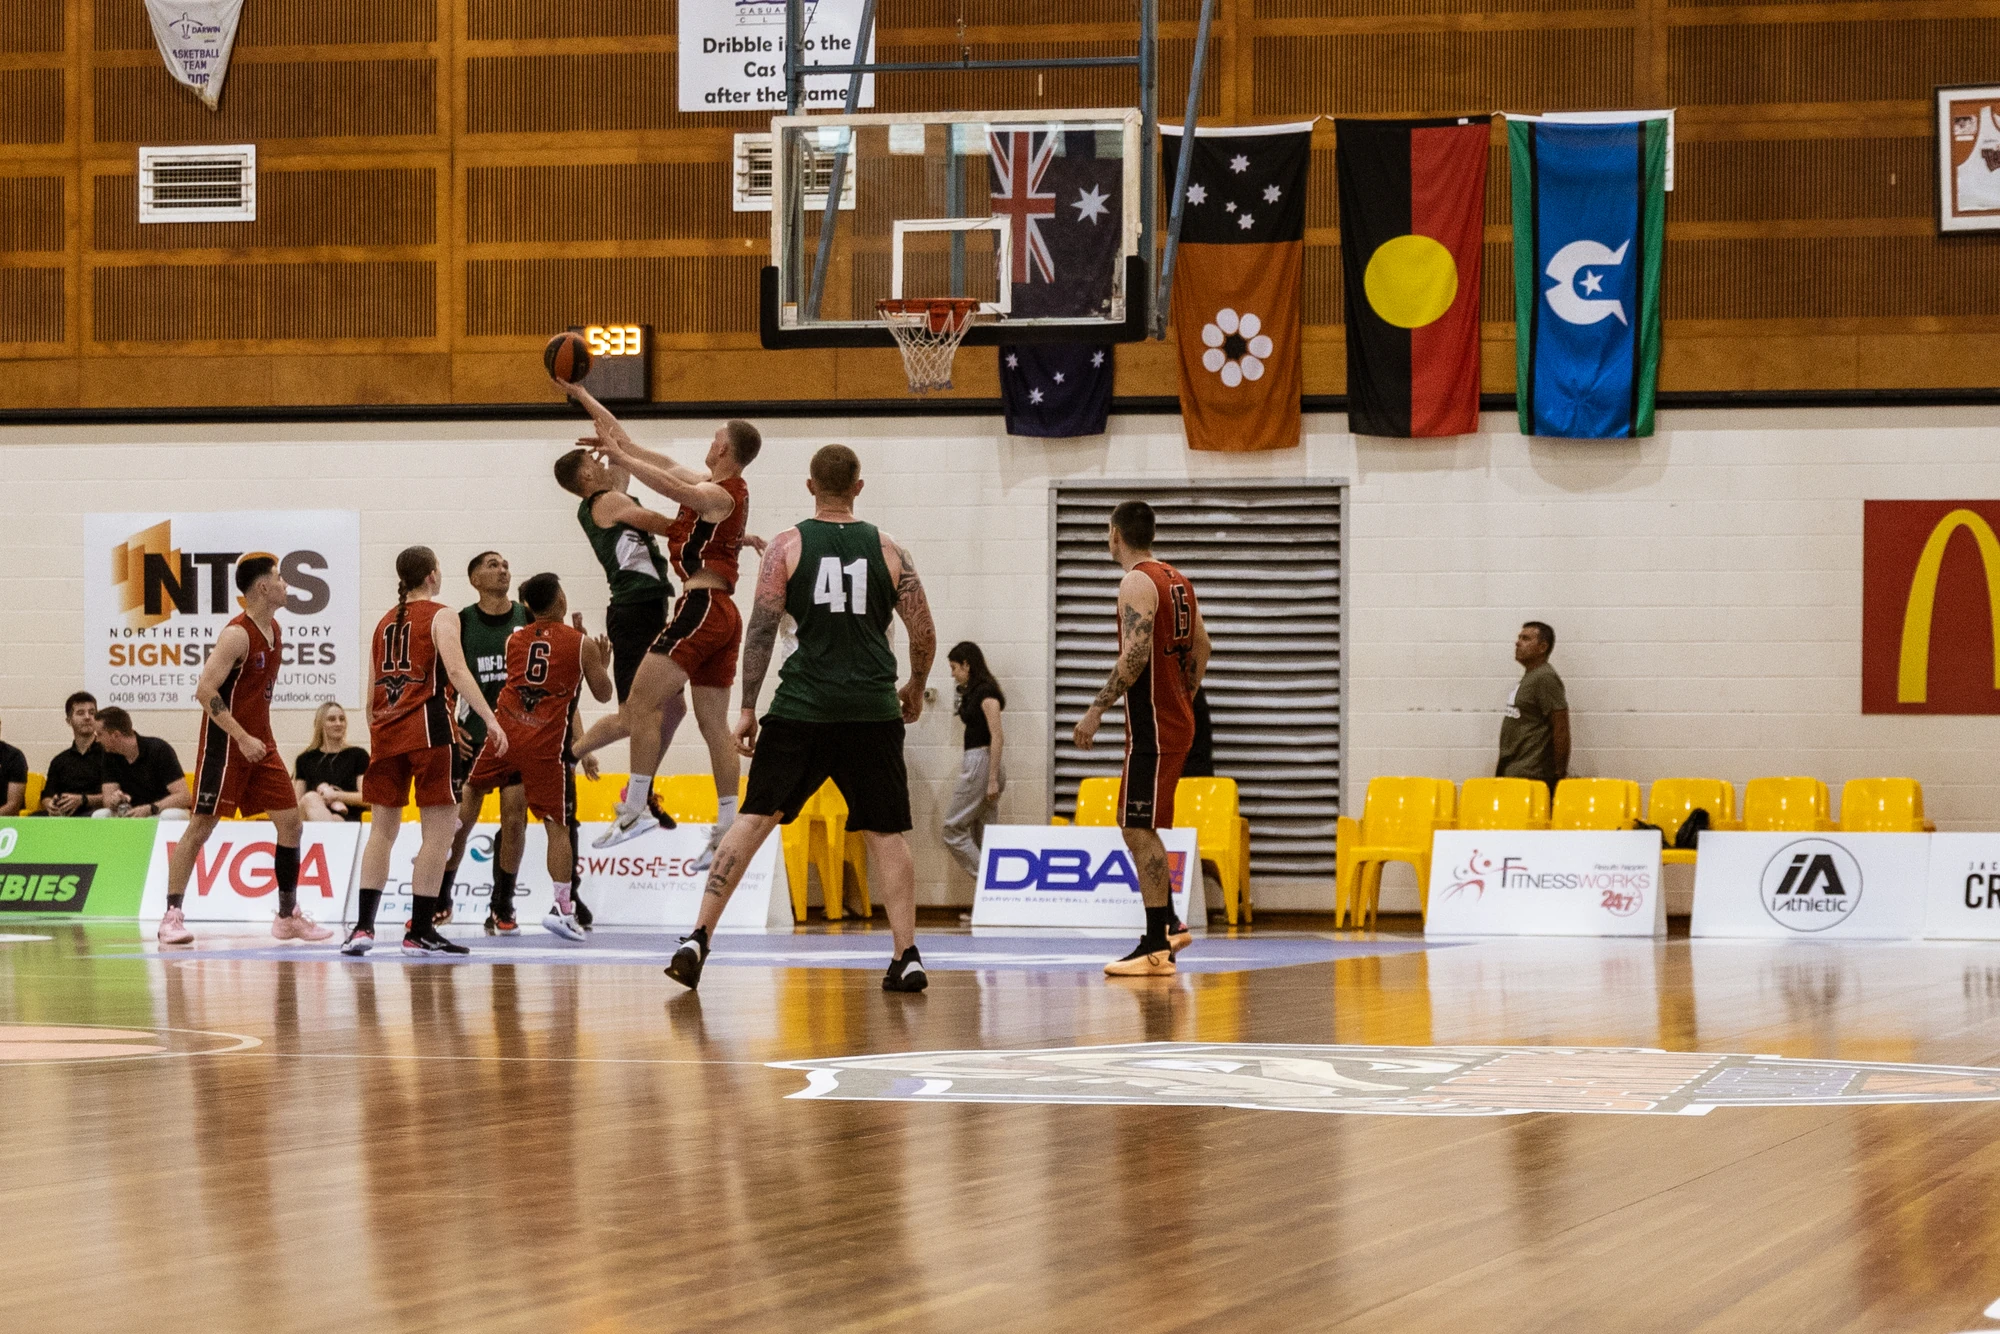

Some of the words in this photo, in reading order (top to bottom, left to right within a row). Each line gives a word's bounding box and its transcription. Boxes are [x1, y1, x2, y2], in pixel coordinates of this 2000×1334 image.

[740, 7, 813, 16] CASUAA
[192, 26, 221, 34] DARWIN
[703, 36, 772, 53] Dribble
[779, 35, 815, 53] io
[821, 34, 851, 50] the
[173, 49, 219, 58] ASKETBALL
[183, 60, 207, 70] TEAM
[744, 61, 776, 77] Cas
[705, 87, 750, 104] after
[757, 86, 787, 103] the
[804, 89, 848, 101] ame
[588, 327, 641, 356] 5:33
[813, 556, 868, 615] 41
[109, 627, 213, 638] NORTHERN
[382, 621, 412, 672] 11
[525, 641, 551, 685] 6
[110, 674, 185, 686] COMPLETE
[276, 672, 337, 685] LUTIONS
[109, 692, 135, 703] 0408
[138, 692, 157, 703] 903
[159, 692, 179, 703] 738
[984, 848, 1141, 893] DBA
[0, 874, 81, 902] BIES
[629, 881, 697, 891] ANALYTICS
